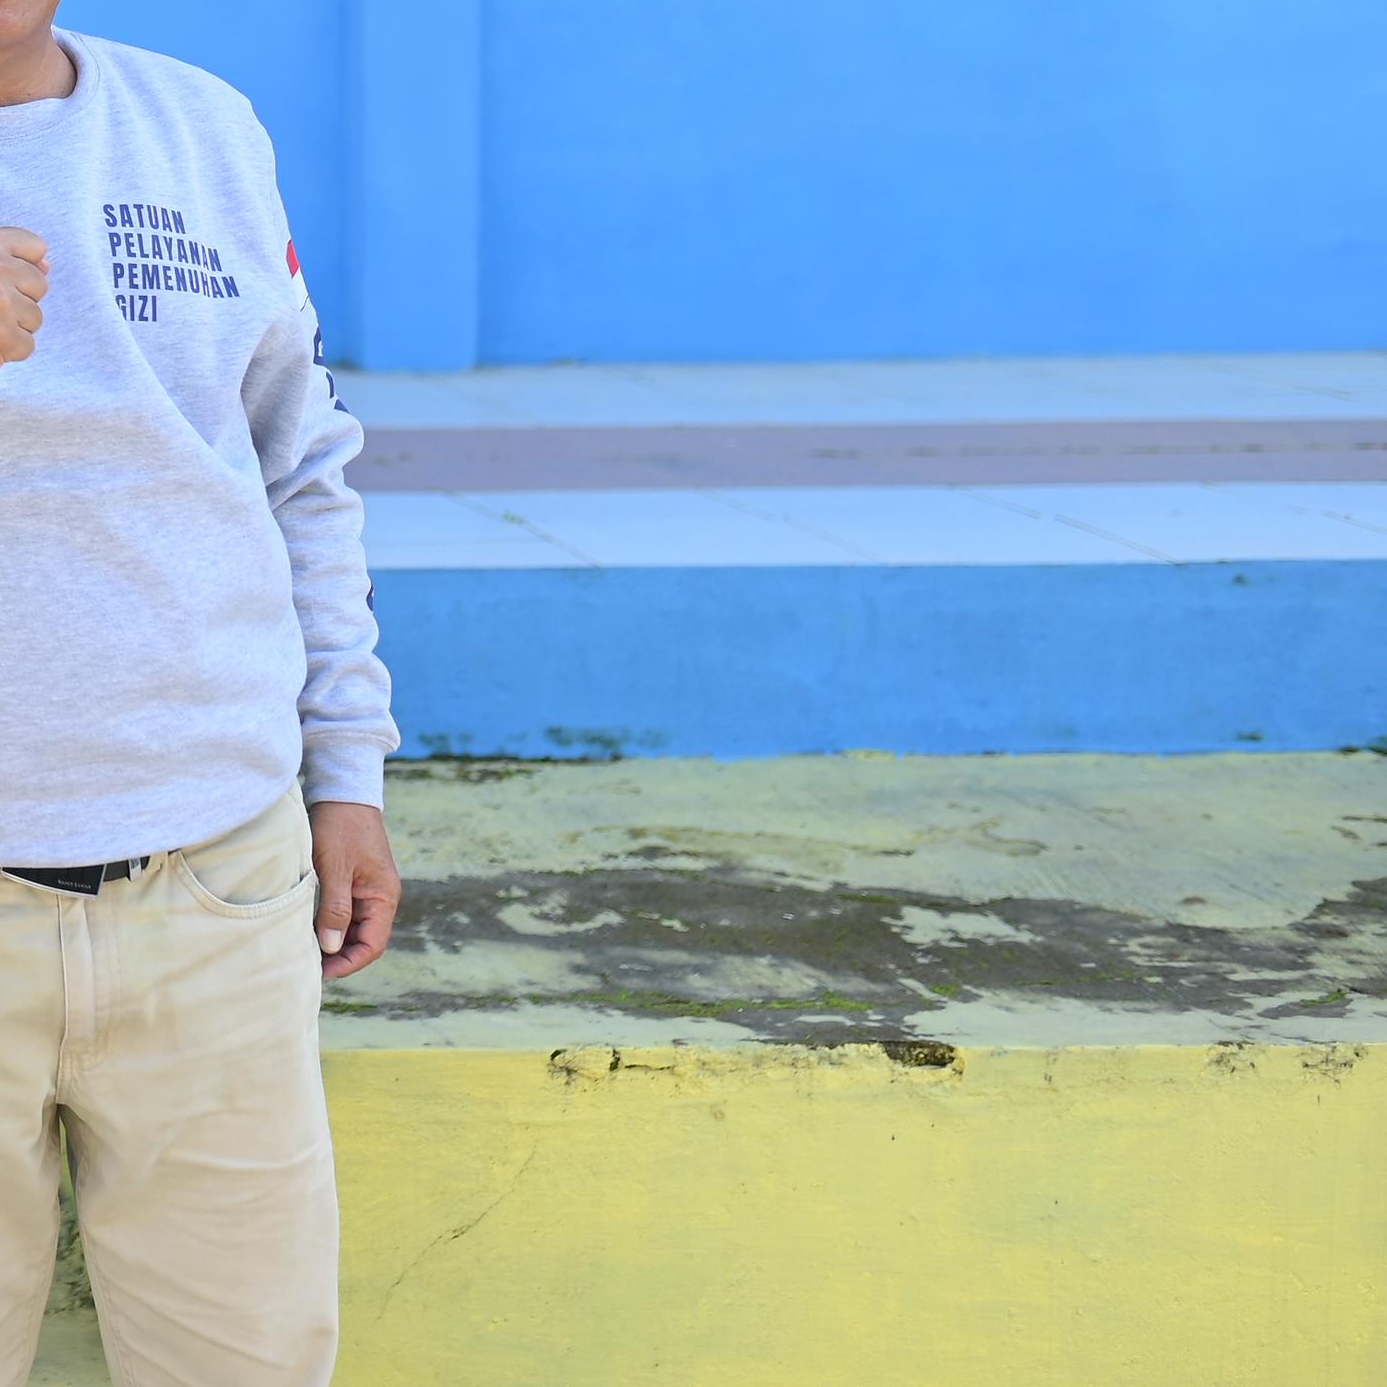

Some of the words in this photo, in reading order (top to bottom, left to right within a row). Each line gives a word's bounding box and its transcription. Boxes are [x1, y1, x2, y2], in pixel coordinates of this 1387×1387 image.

[103, 203, 186, 234] SATUAN
[108, 232, 223, 272] PELAYANAN
[113, 263, 240, 298] PEMENUHAN
[115, 294, 158, 322] GIZI
